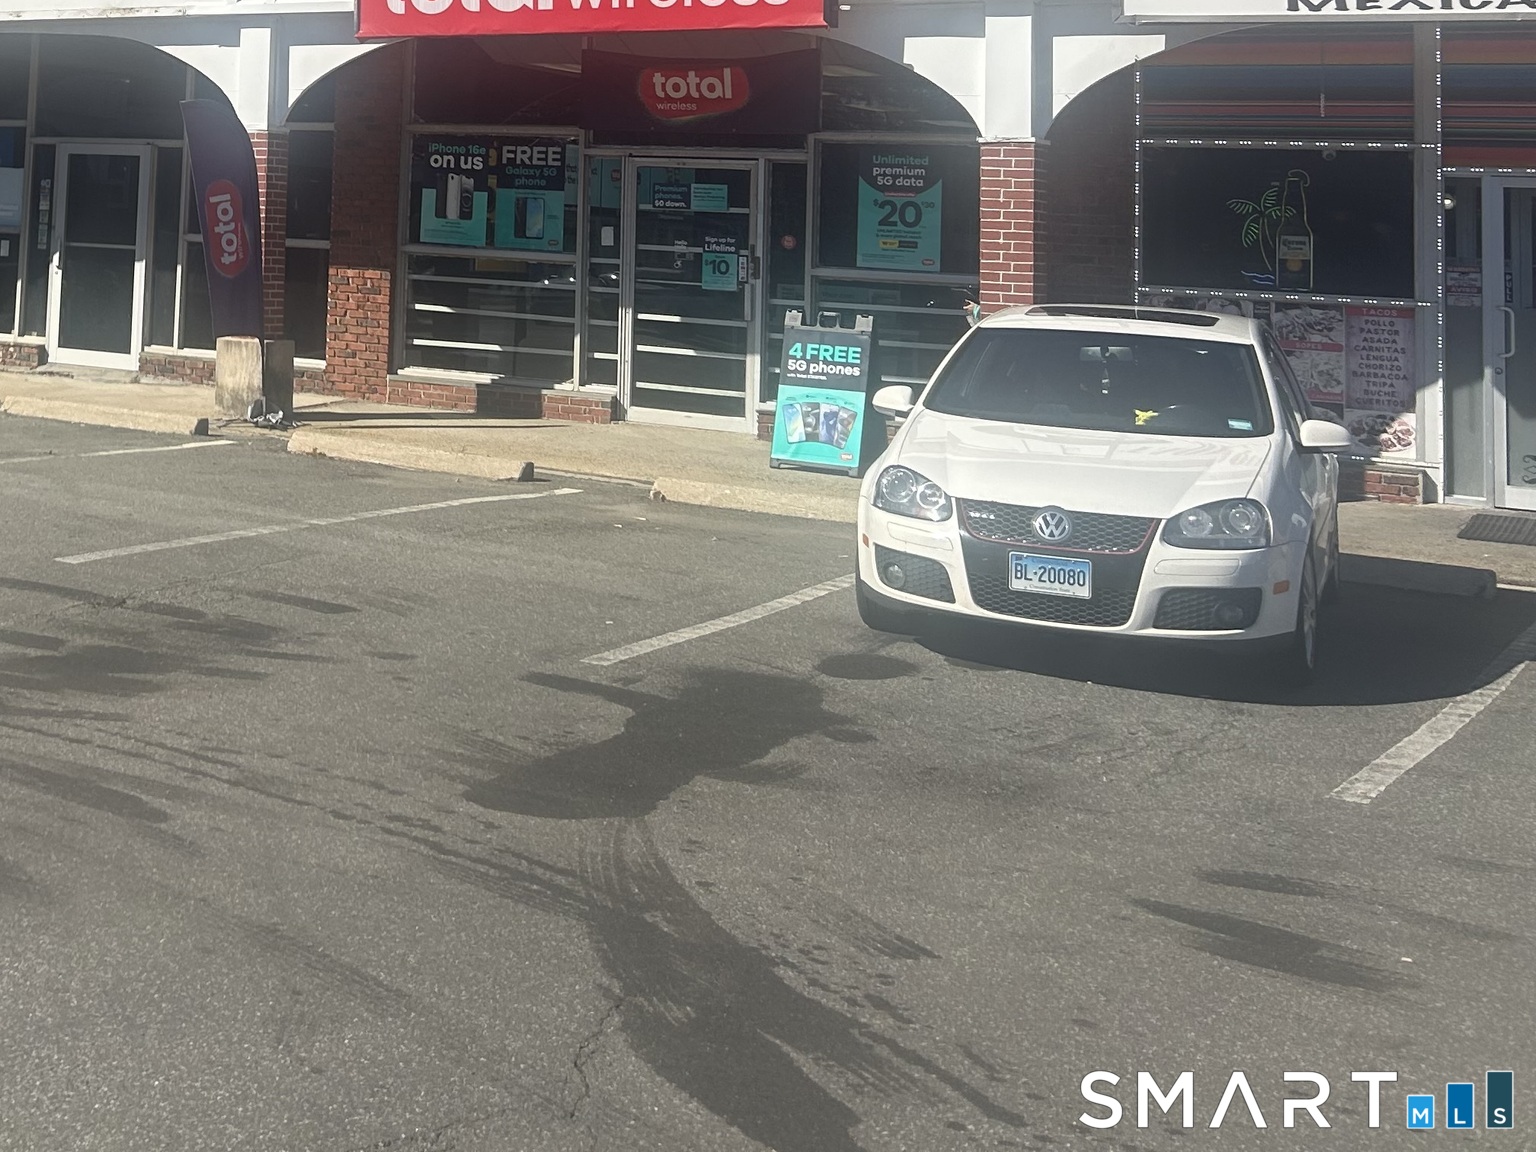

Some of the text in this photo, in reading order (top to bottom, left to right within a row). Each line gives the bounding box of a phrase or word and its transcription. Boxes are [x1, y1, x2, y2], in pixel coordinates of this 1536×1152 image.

[653, 67, 733, 100] total
[656, 100, 697, 111] wireless
[428, 143, 487, 155] iPhone 16e
[502, 145, 562, 166] FREE
[872, 155, 929, 165] Unlimited
[429, 154, 484, 170] on us
[505, 166, 557, 177] Galaxy 5G
[872, 166, 926, 176] premium
[515, 176, 546, 187] phone
[877, 176, 924, 187] 5G data
[654, 185, 688, 193] Premium
[654, 199, 687, 208] $0 down.
[873, 198, 923, 228] $20
[209, 194, 238, 265] total
[704, 244, 736, 252] Lifeline
[704, 259, 730, 276] $10
[1362, 308, 1398, 317] TACOS
[1364, 319, 1395, 327] POLLO
[1359, 327, 1400, 336] PASTOR
[1362, 336, 1398, 345] ASADA
[788, 342, 862, 364] 4 FREE
[1354, 345, 1406, 355] CARNITAS
[1360, 353, 1400, 363] LENGUA
[787, 359, 861, 376] 5G phones
[1358, 362, 1402, 371] CHORIZO
[1352, 370, 1408, 381] BARBACOA
[1365, 380, 1396, 388] TRIPA
[1364, 389, 1396, 397] BUCHE
